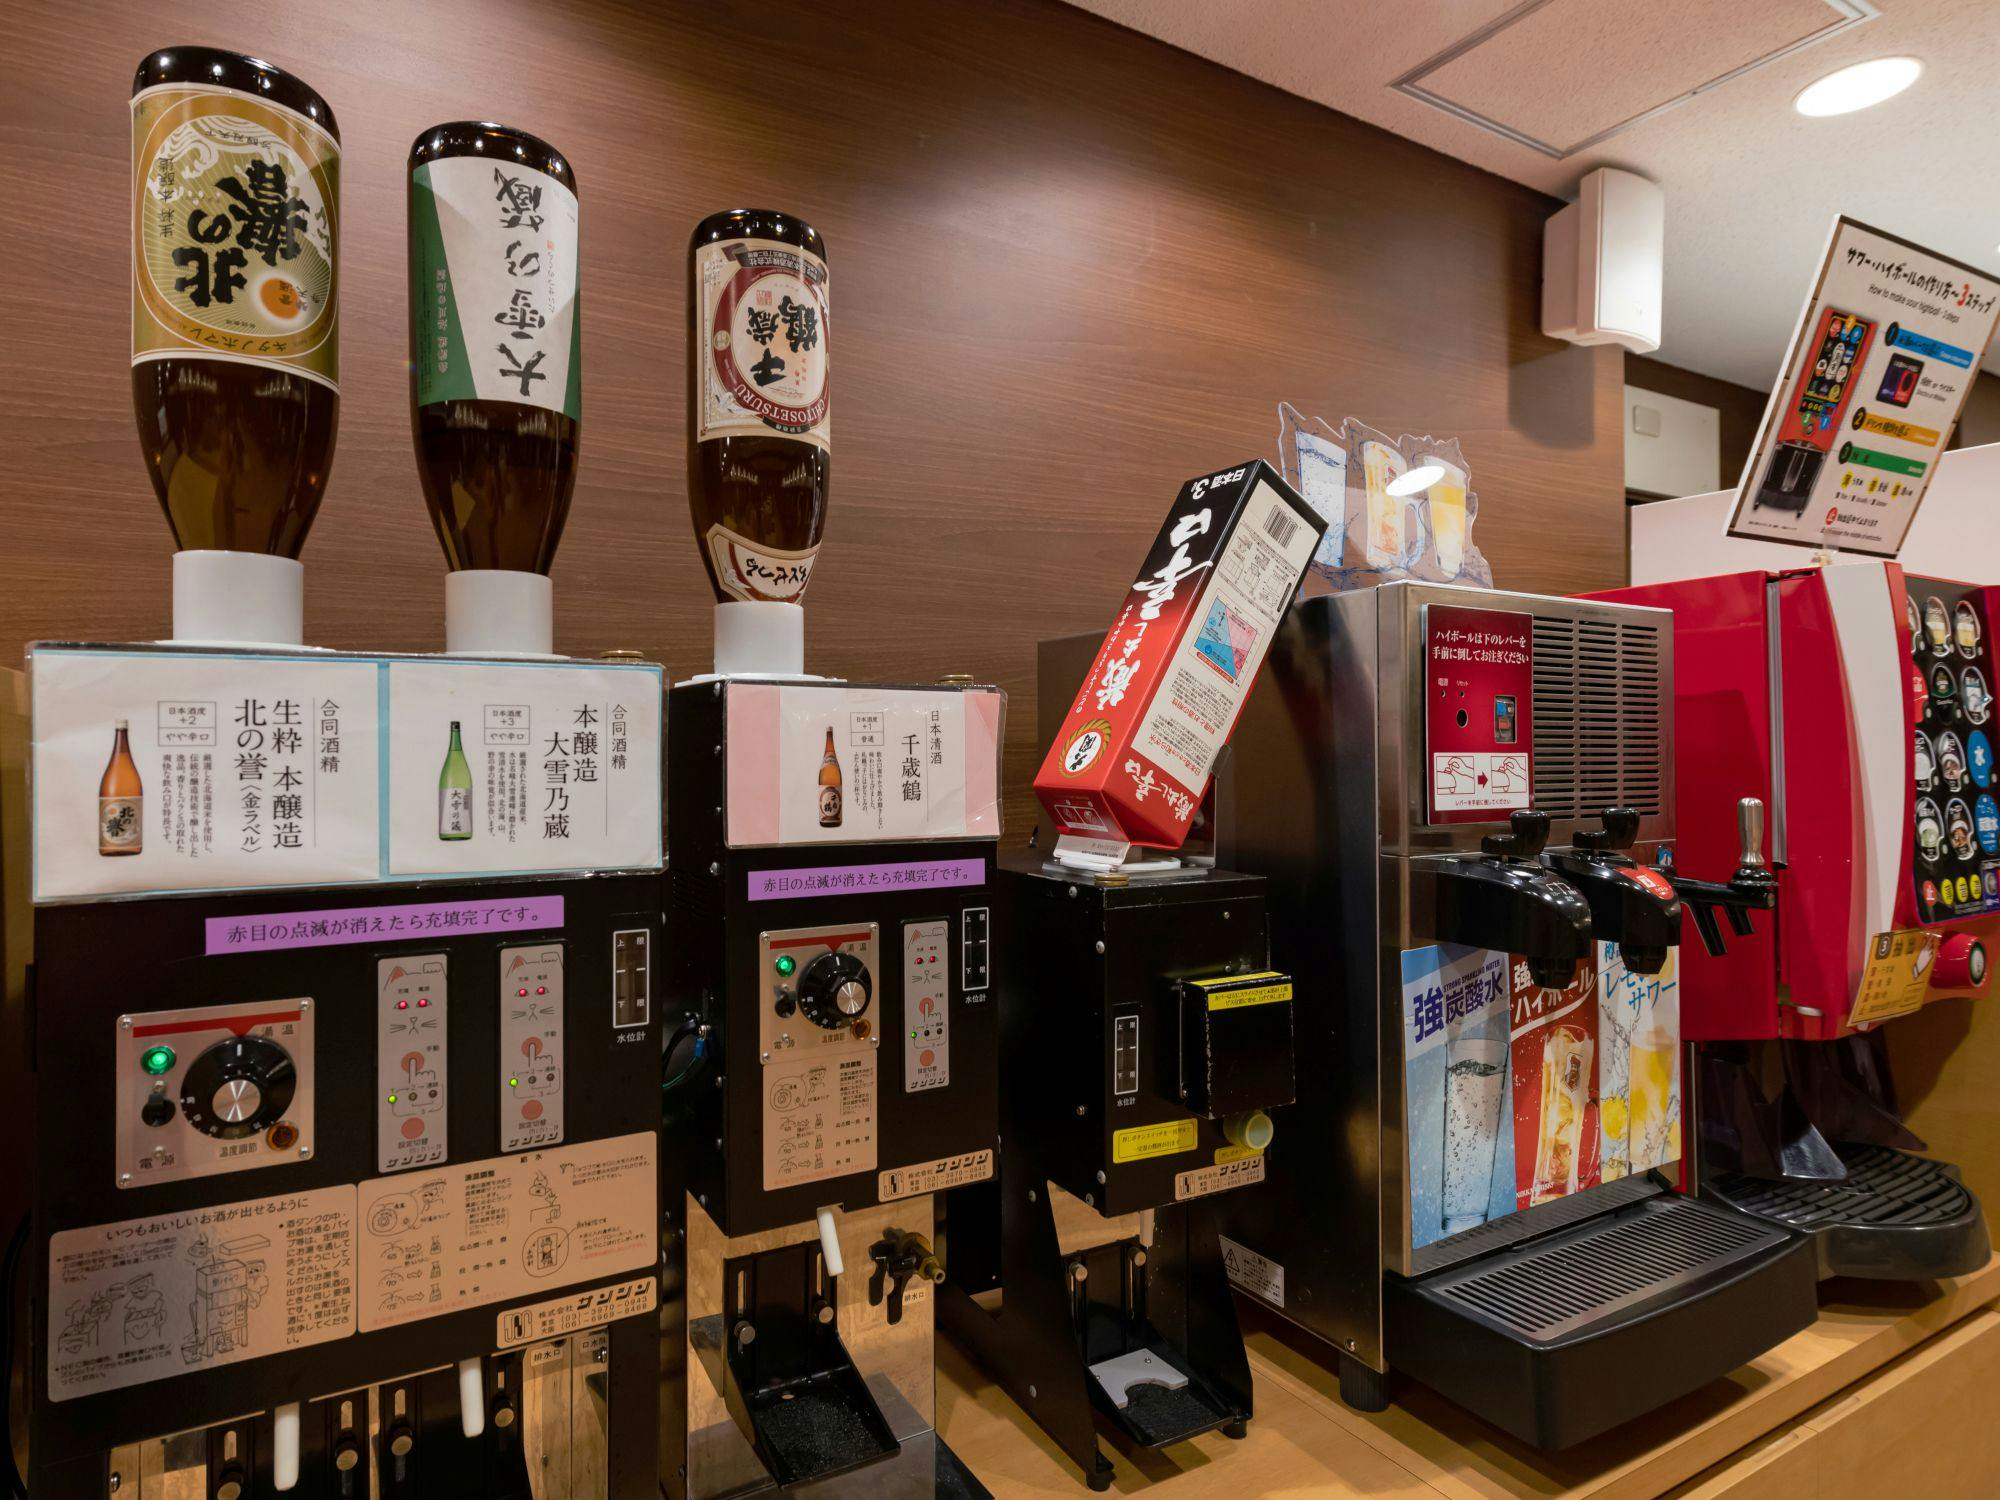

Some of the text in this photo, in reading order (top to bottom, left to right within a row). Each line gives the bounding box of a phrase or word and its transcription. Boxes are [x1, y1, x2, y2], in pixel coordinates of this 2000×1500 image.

[1432, 646, 1530, 665] 手前に倒してお注ぎください
[1435, 630, 1527, 648] ハイボールは下のレバーを
[168, 706, 206, 717] 日本酒度
[166, 733, 210, 742] やや辛口
[320, 699, 341, 773] 合同酒精
[573, 704, 599, 782] 本醸造
[611, 703, 628, 770] 合同酒精
[930, 710, 943, 765] 日本清酒
[271, 700, 303, 849] 生粋 本醸造
[543, 732, 570, 840] 大雪乃蔵
[901, 733, 921, 802] 千歳鶴
[763, 868, 970, 893] 赤目の点滅が消えたら充填完了です。
[227, 906, 540, 944] 赤目の点滅が消えたら充填完了です。
[1413, 971, 1504, 1044] 強炭酸水
[1629, 980, 1677, 1018] サワー
[616, 1032, 646, 1044] 水位計
[538, 1305, 574, 1319] 株式会社
